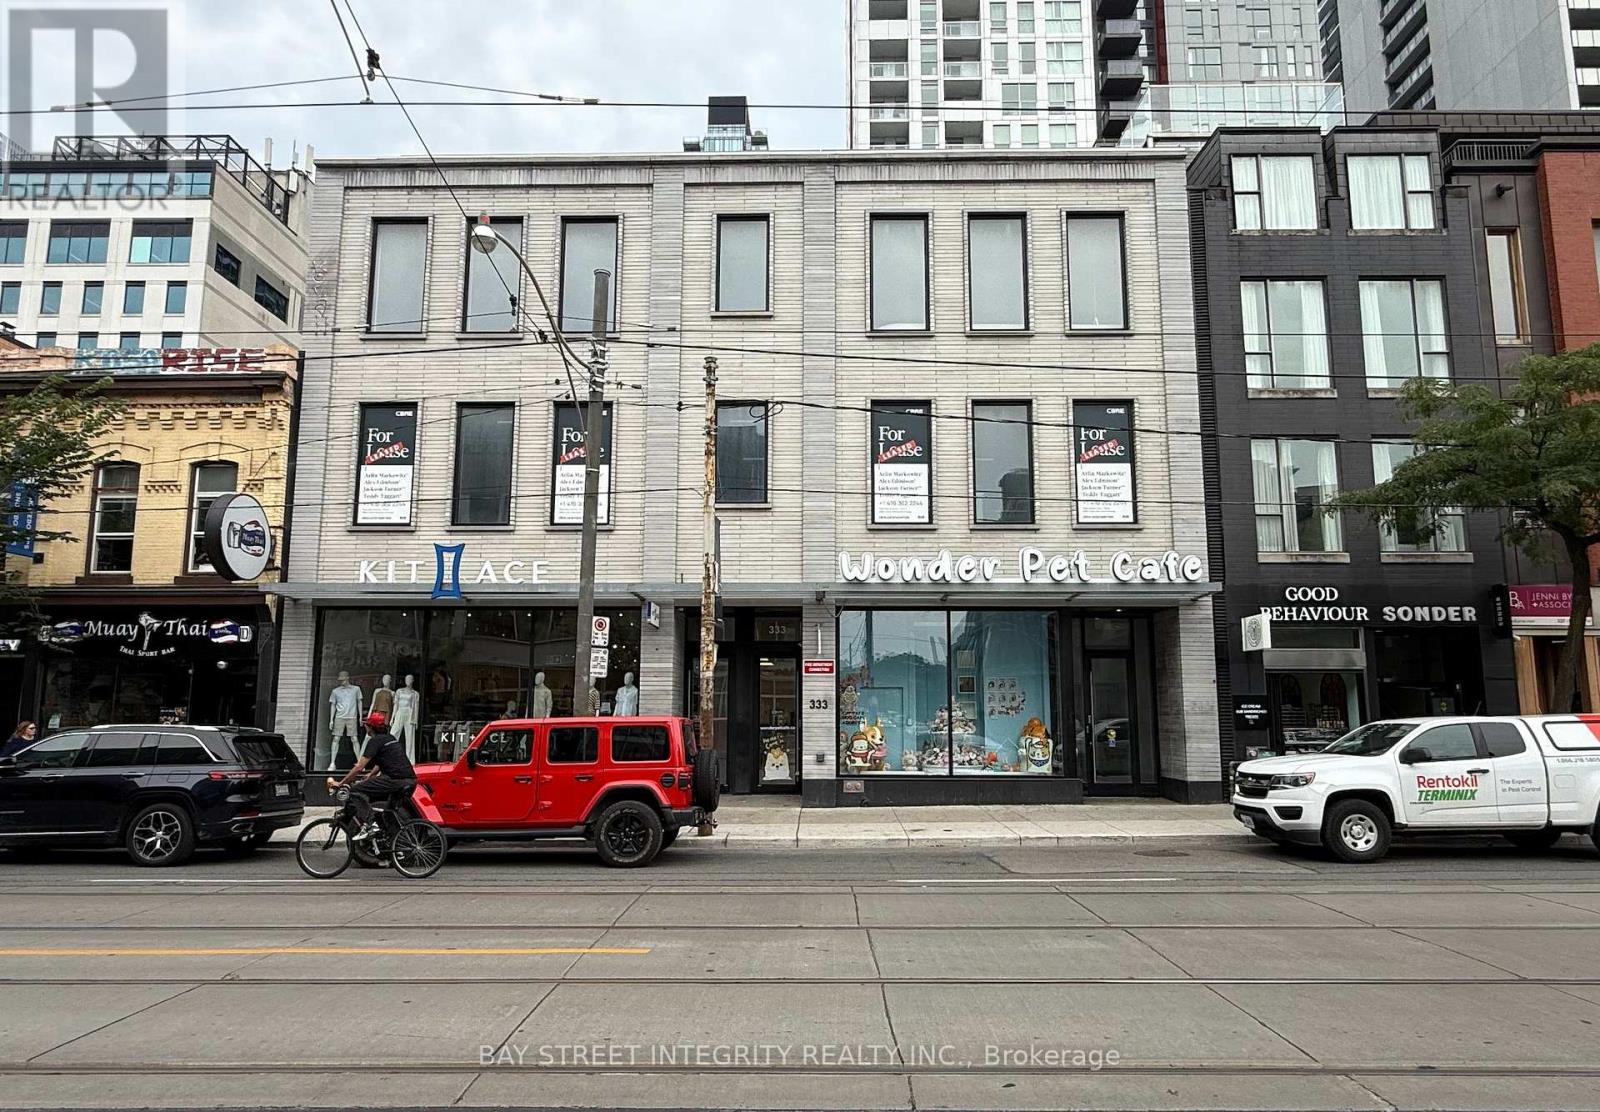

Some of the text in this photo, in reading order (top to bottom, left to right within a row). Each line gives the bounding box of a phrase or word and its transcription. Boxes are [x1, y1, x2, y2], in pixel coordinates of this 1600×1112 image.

[367, 428, 394, 442] For
[562, 427, 588, 442] For
[878, 426, 906, 442] For
[1080, 427, 1107, 440] For
[839, 546, 1203, 583] Wonder Pet Cafe
[358, 560, 550, 585] KIT ACE
[1286, 586, 1338, 601] GOOD
[1532, 592, 1559, 601] JENNI
[1260, 606, 1477, 622] BEHAVIOUR SONDER
[83, 618, 208, 642] Muay Thai
[769, 626, 786, 634] 333
[809, 700, 828, 709] 333
[441, 732, 466, 742] KIT
[1416, 775, 1478, 788] Rentokil
[1418, 789, 1478, 801] TERMINIX
